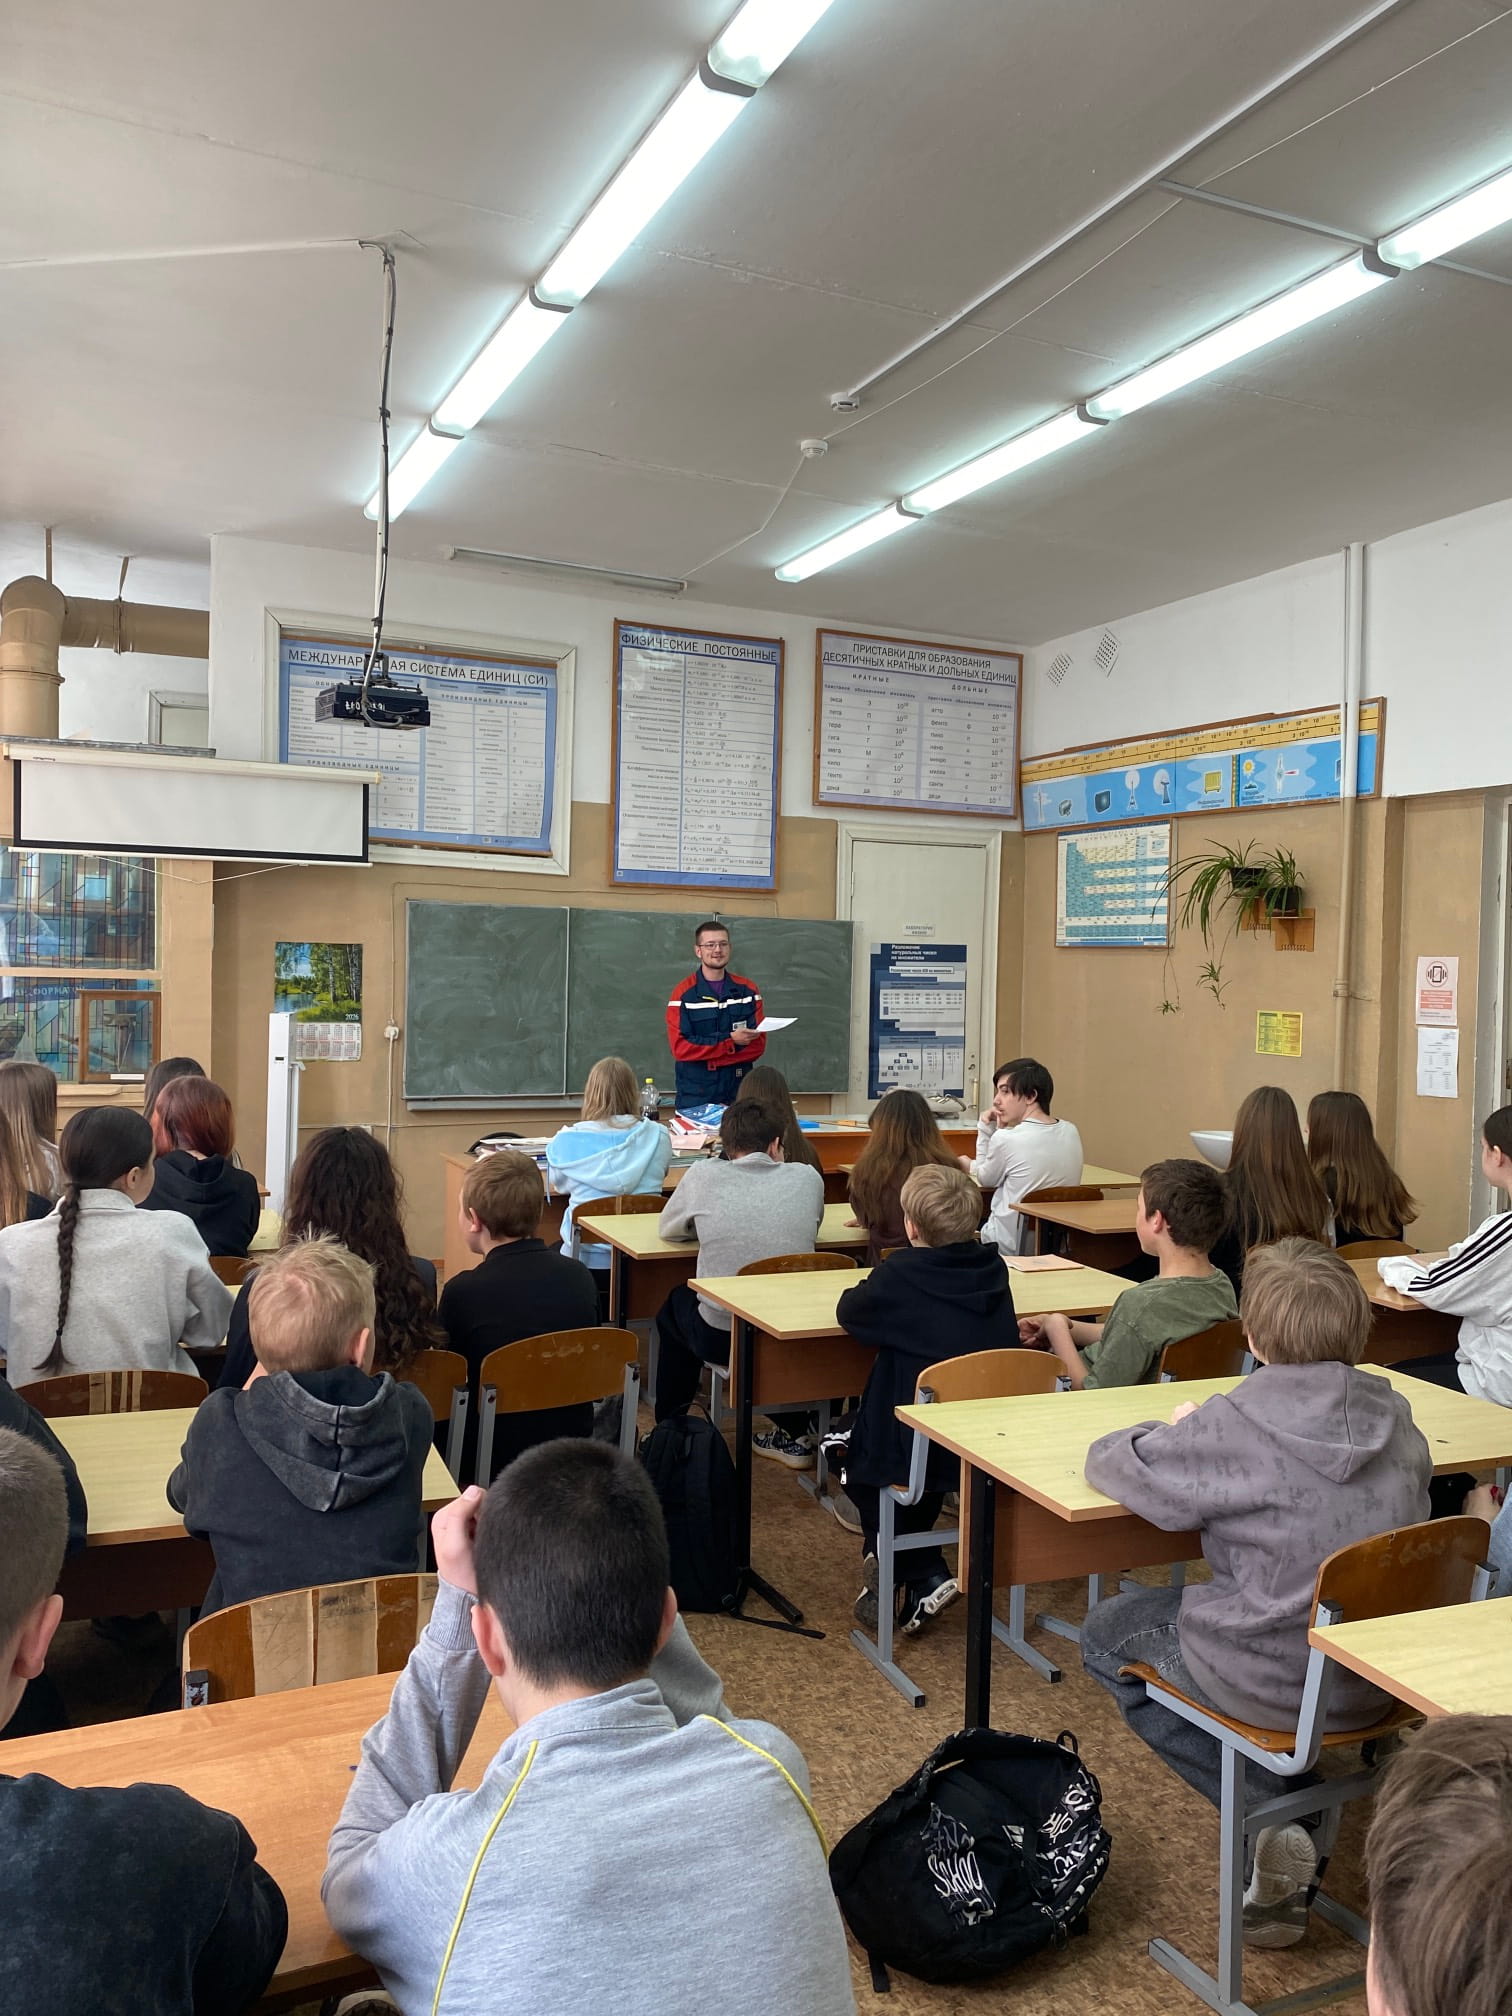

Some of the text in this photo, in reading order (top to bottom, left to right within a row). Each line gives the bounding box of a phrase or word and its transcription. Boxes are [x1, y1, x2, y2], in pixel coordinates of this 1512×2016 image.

[621, 633, 777, 662] ФИЗИЧЕСКИЕ ПОСТОЯННЫЕ
[853, 643, 991, 669] ПРИСТАВКИ ДЛЯ ОБРАЗОВАНИЯ
[288, 649, 548, 687] МЕЖДУНАРДАЯ СИСТЕМА ЕДИНИЦ (СИ)
[822, 651, 1017, 684] ДЕСЯТИЧНЫХ КРАТНЫХ И ДОЛЬНЫХ ЕДИНИЦ
[852, 673, 889, 683] КРАТНЫЕ
[951, 684, 988, 693] ДОЛЬНЫЕ
